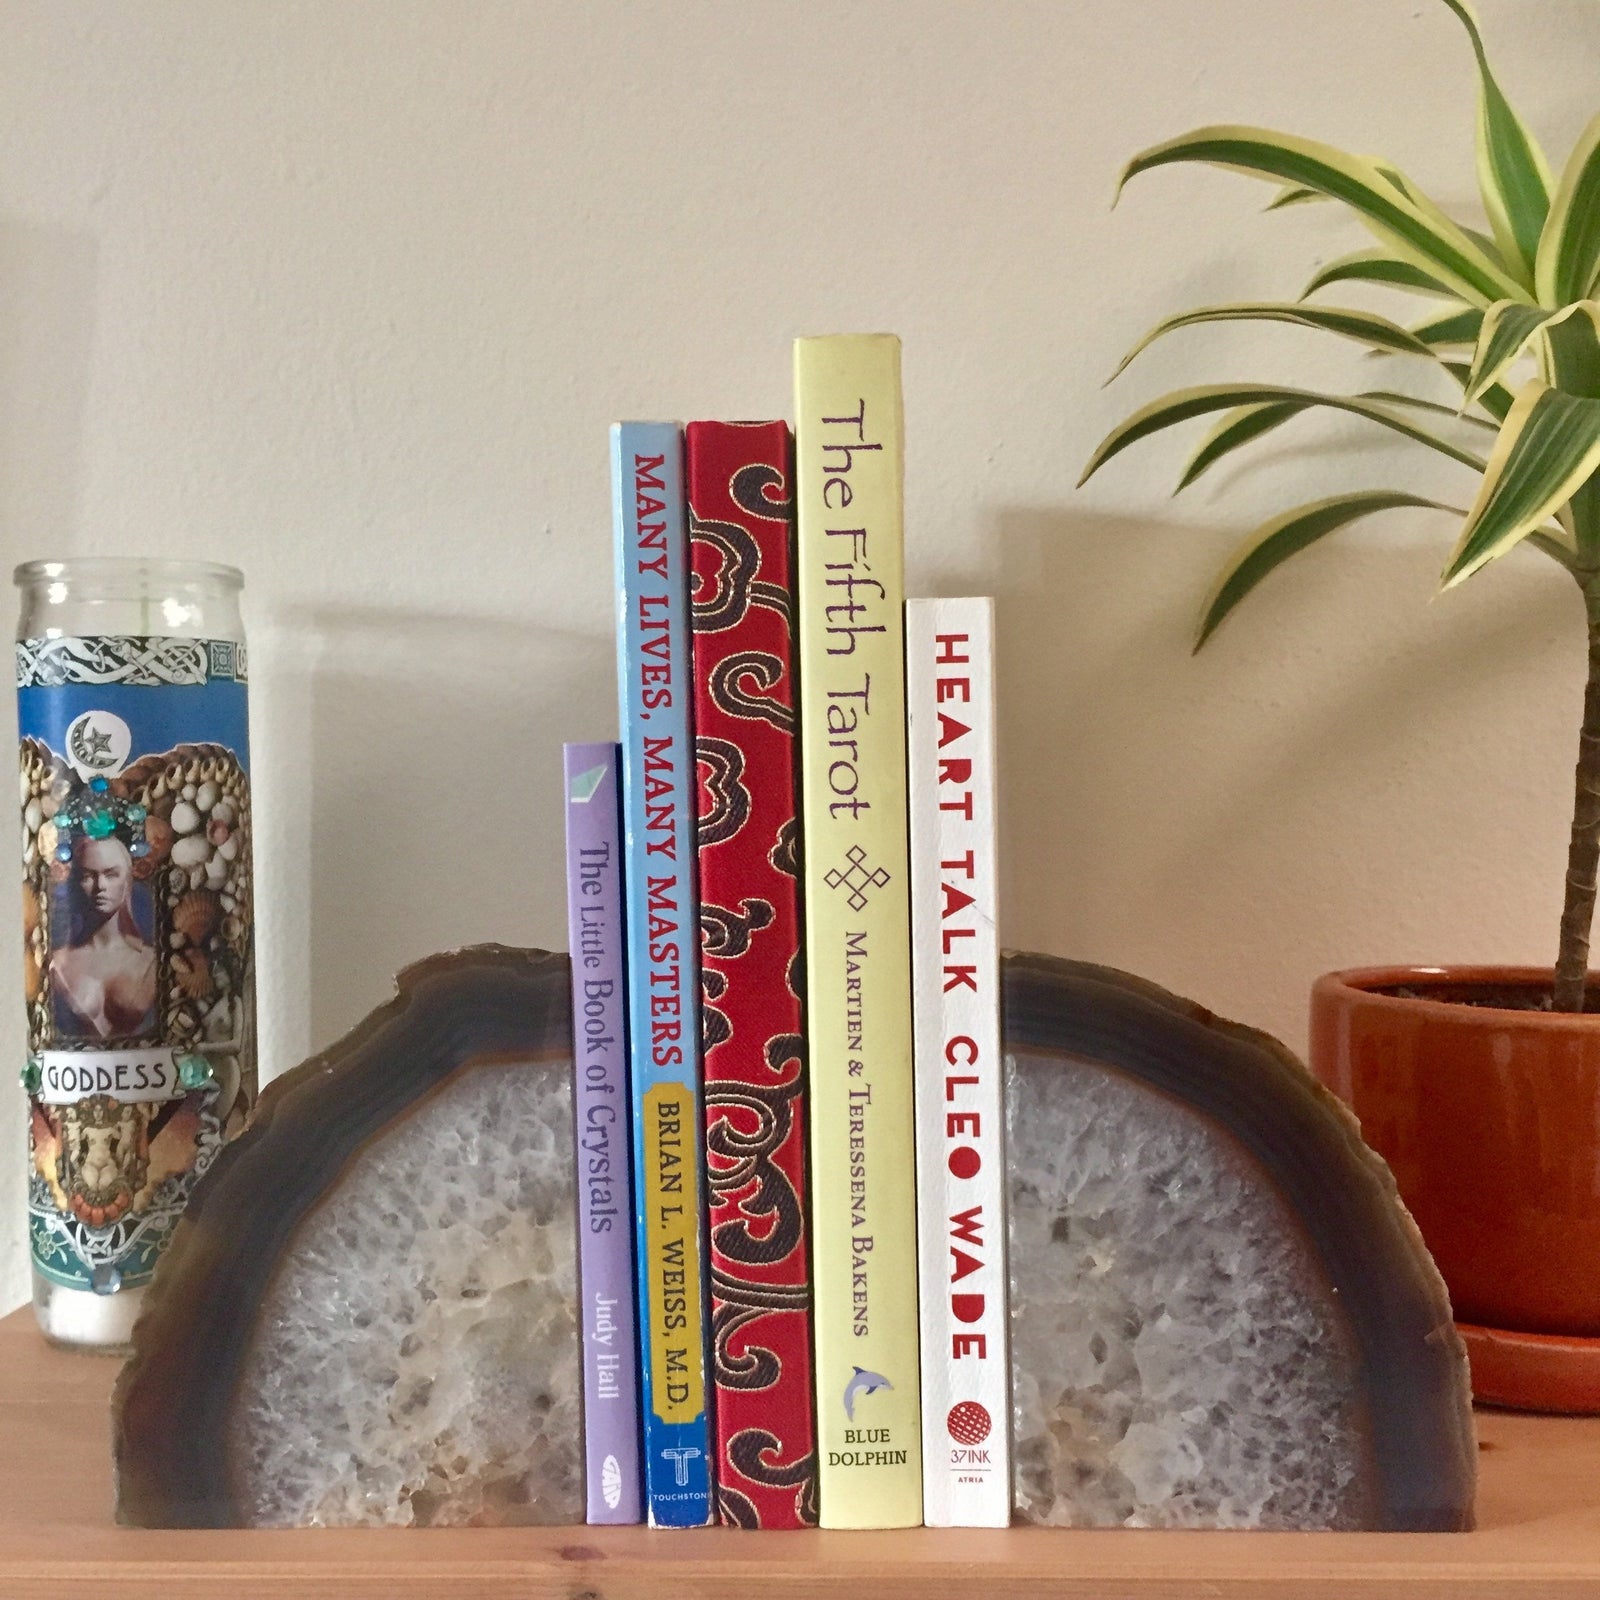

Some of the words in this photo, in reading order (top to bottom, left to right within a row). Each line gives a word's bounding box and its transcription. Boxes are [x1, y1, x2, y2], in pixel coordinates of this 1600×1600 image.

[821, 397, 884, 509] The
[634, 453, 669, 580] MANY
[824, 528, 887, 656] Fifth
[638, 594, 673, 720] LIVES,
[827, 672, 871, 820] Tarot
[935, 633, 973, 821] HEART
[643, 736, 677, 861] MANY
[580, 841, 610, 896] The
[580, 906, 605, 968] Little
[940, 849, 978, 993] TALK
[584, 979, 616, 1054] Book
[646, 875, 683, 1067] MASTERS
[845, 930, 868, 1052] MARTIEN
[47, 1062, 168, 1092] GODDESS
[585, 1065, 615, 1095] of
[848, 1059, 865, 1077] &
[945, 1035, 982, 1180] CLEO
[582, 1105, 618, 1234] Crystals
[658, 1101, 683, 1193] BRIAN
[661, 1205, 683, 1229] L.
[592, 1292, 618, 1347] Judy
[661, 1237, 687, 1337] WEISS,
[851, 1235, 874, 1338] BAKENS
[949, 1205, 987, 1360] WADE
[597, 1354, 620, 1399] Hall
[665, 1348, 689, 1410] M.D.
[828, 1450, 907, 1467] DOLPHIN
[844, 1428, 891, 1443] BLUE
[950, 1450, 992, 1464] 37INK
[957, 1476, 984, 1484] ATRIA
[653, 1492, 711, 1501] TOUCHSTON
